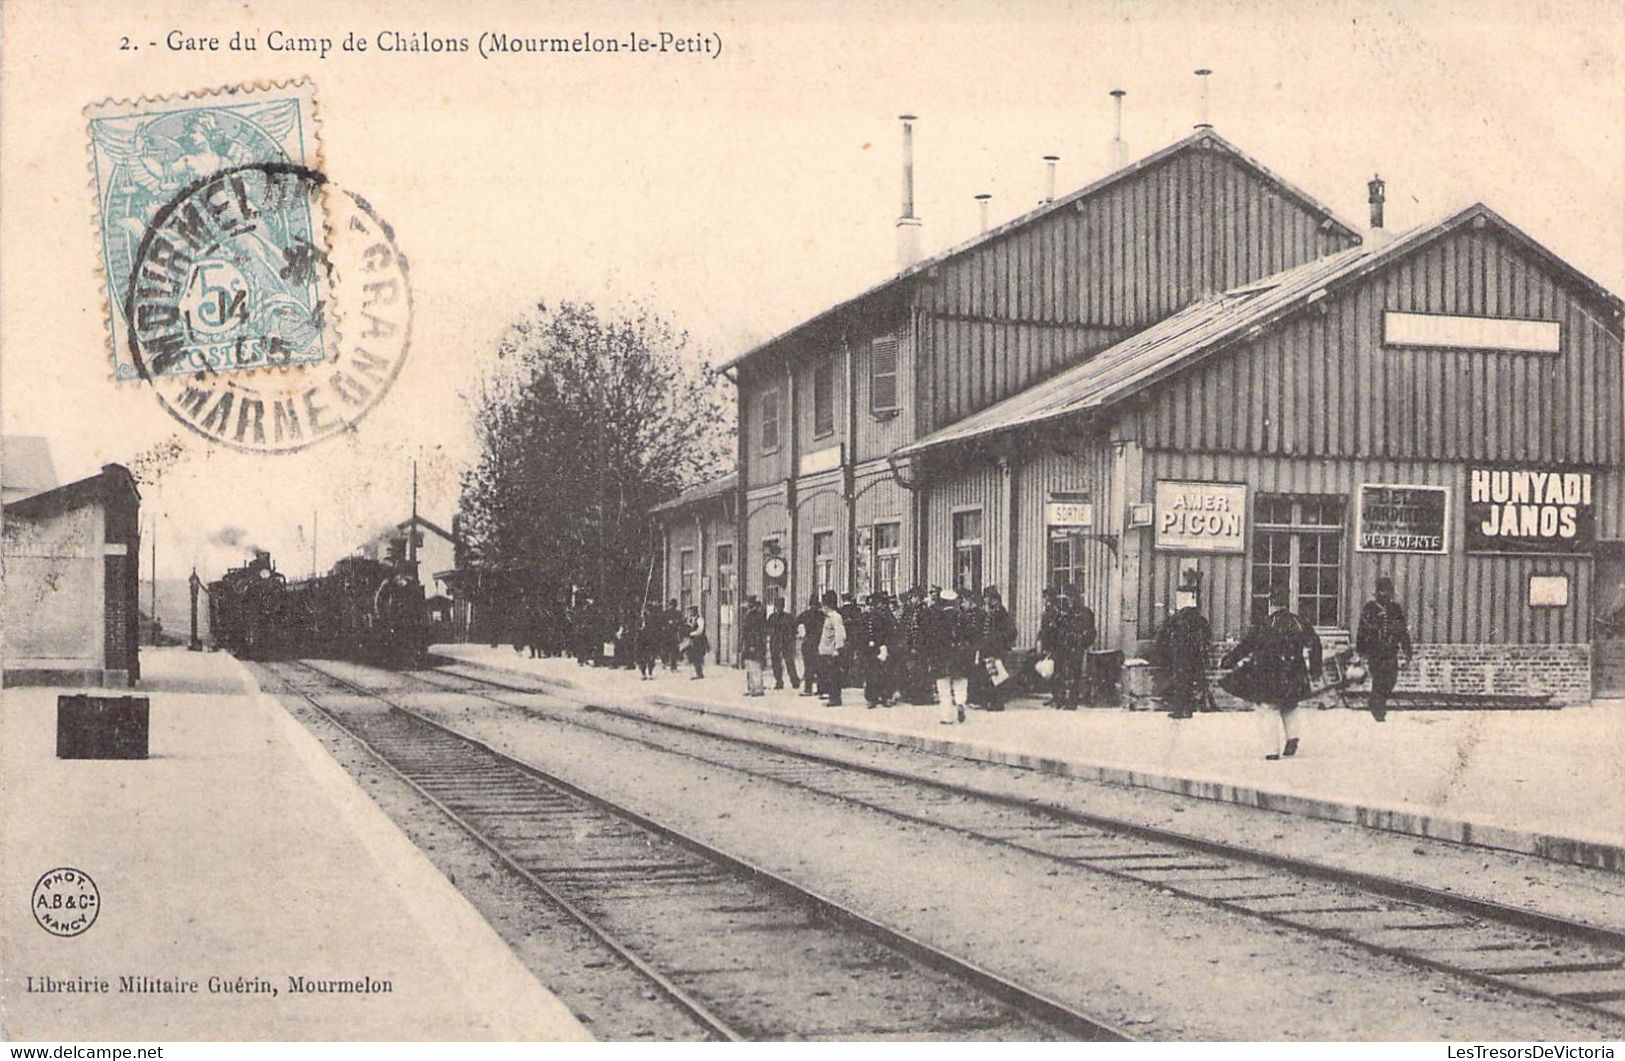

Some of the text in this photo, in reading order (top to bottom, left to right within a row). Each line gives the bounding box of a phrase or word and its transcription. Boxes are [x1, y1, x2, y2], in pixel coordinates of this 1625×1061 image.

[177, 386, 341, 444] MARNE
[1173, 493, 1230, 513] AMER
[1471, 470, 1592, 505] HUNYADI
[1161, 511, 1241, 538] PICON
[1481, 501, 1577, 538] JÁNOS
[1362, 531, 1442, 549] VÊTEMENTS
